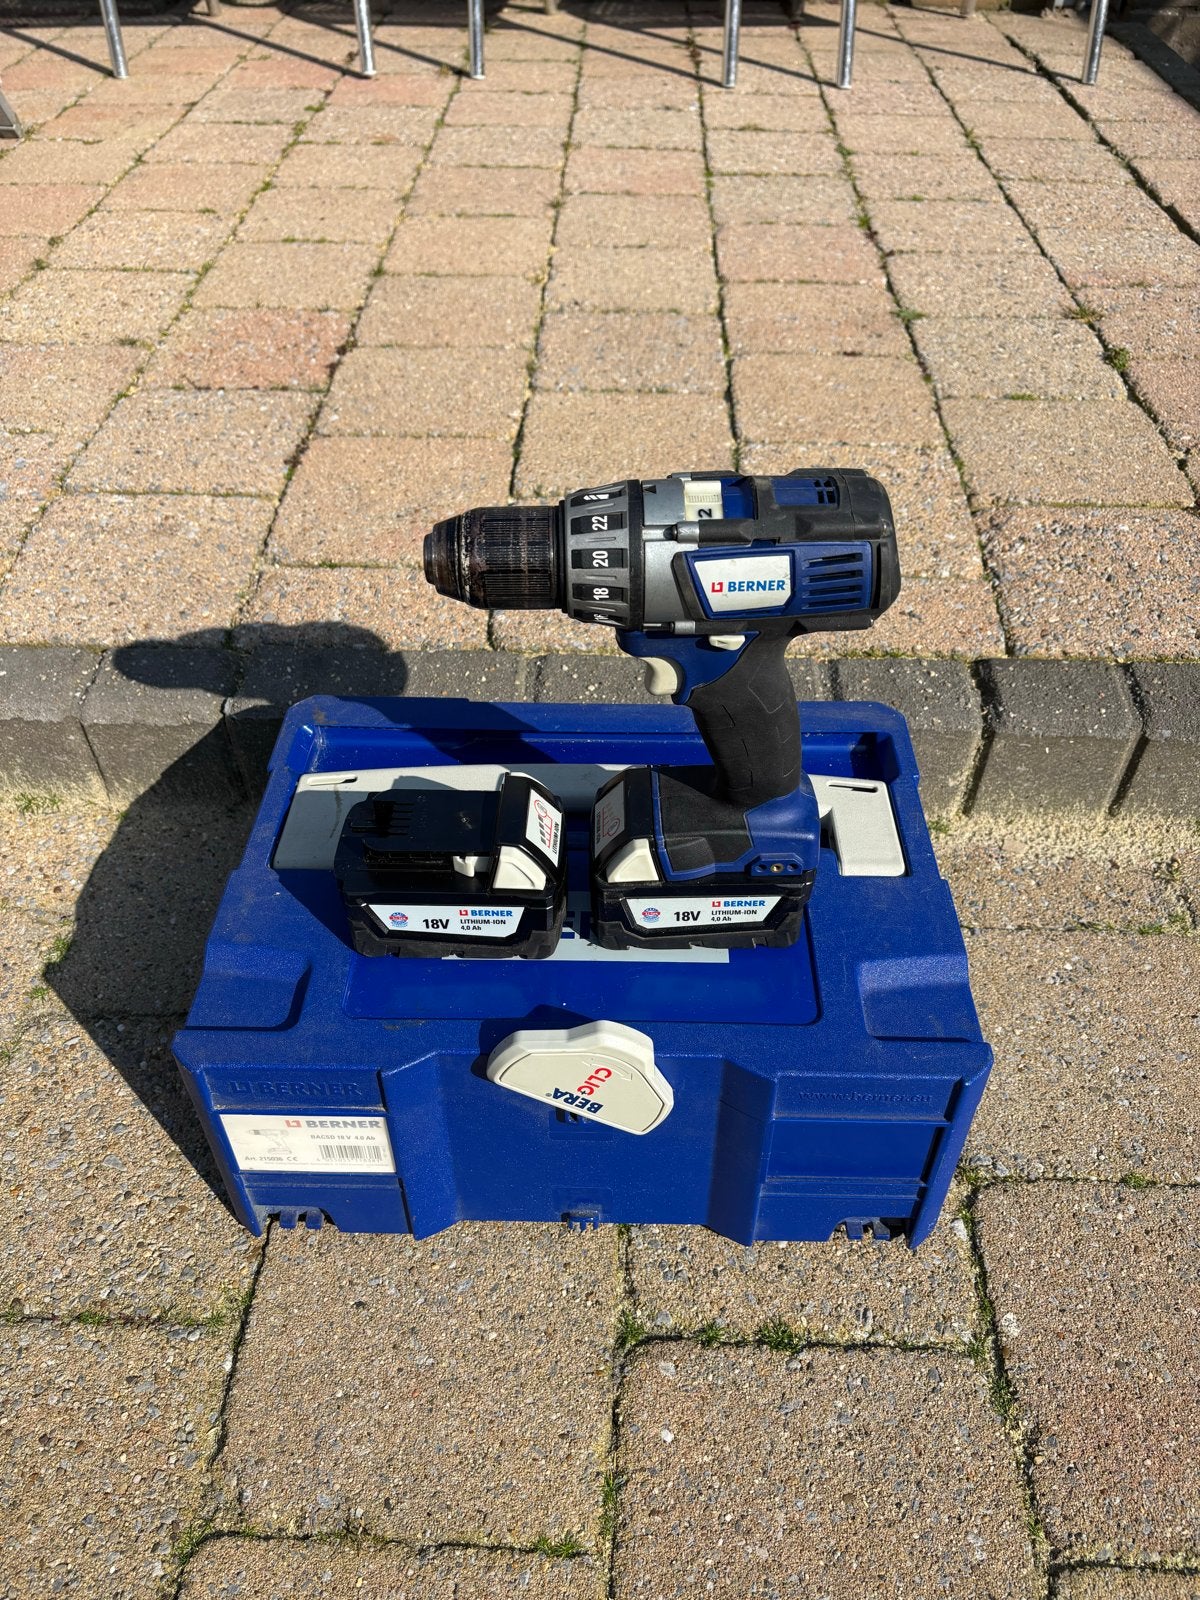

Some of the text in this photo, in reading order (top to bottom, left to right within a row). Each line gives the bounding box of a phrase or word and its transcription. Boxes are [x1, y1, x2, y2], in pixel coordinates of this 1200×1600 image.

[698, 508, 713, 518] 2
[592, 515, 608, 531] 22
[592, 550, 609, 567] 20
[727, 580, 786, 592] BERNER
[593, 587, 610, 600] 18
[470, 909, 513, 917] BERNER
[673, 911, 701, 922] 18V
[422, 918, 450, 930] 18V
[260, 1081, 363, 1096] BERNER
[305, 1120, 382, 1128] BERNER
